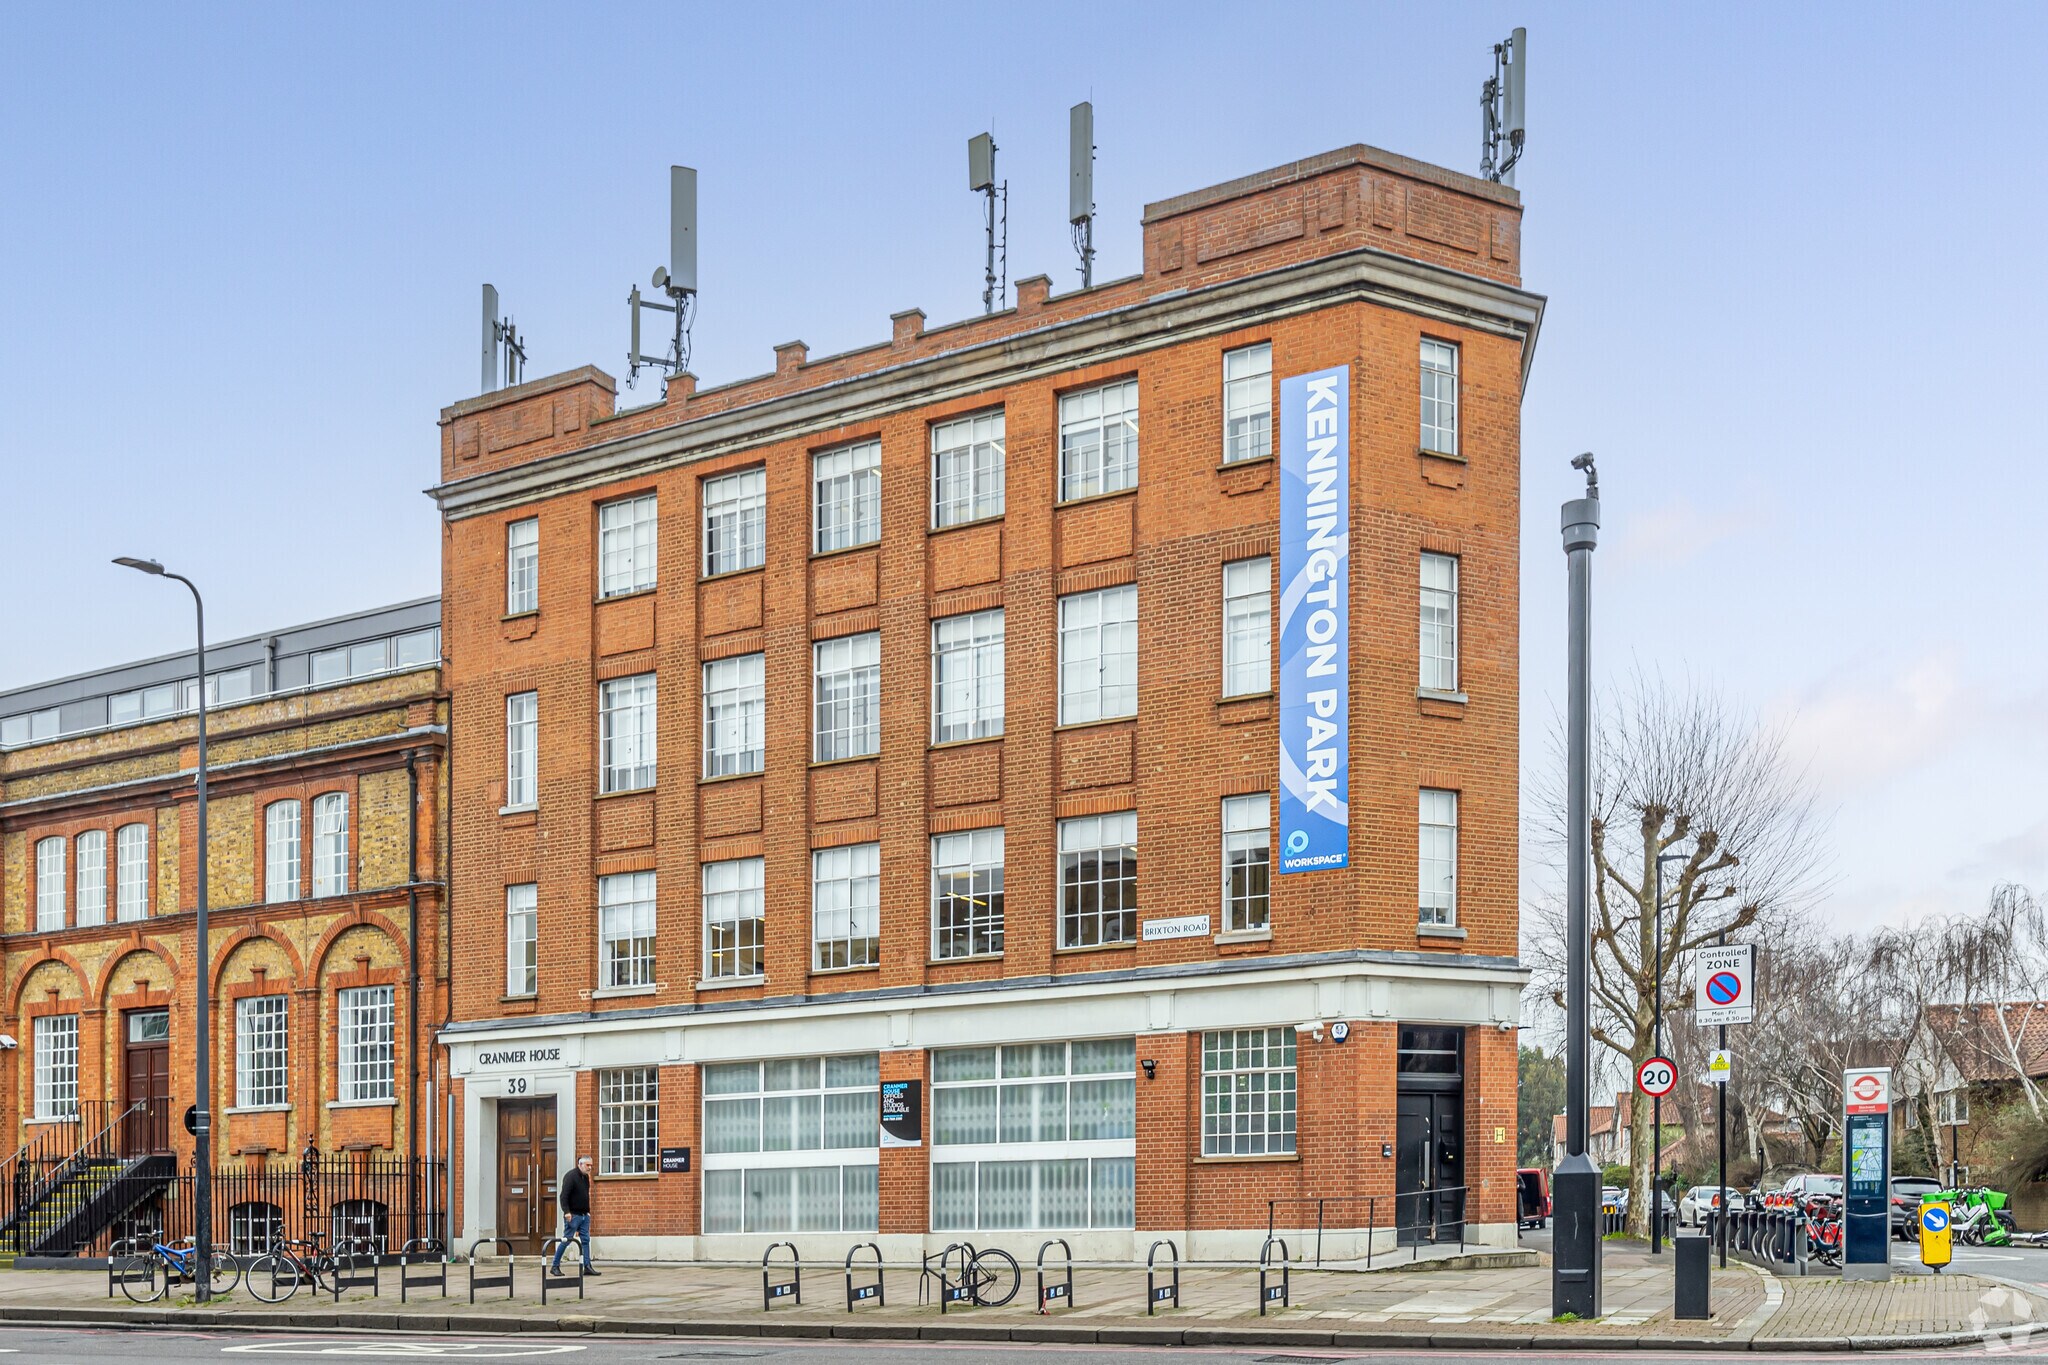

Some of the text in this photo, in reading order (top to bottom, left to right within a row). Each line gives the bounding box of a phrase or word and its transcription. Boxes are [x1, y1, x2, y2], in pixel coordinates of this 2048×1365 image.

[1306, 375, 1338, 813] KENNINGTON PARK
[1284, 853, 1343, 869] WORKSPACE
[1144, 923, 1208, 936] BRIXTON ROAD
[1699, 948, 1748, 959] Controlled
[1706, 958, 1740, 970] ZONE
[479, 1048, 561, 1065] CRANMER HOUSE
[1643, 1069, 1671, 1085] 20
[508, 1077, 527, 1094] 39
